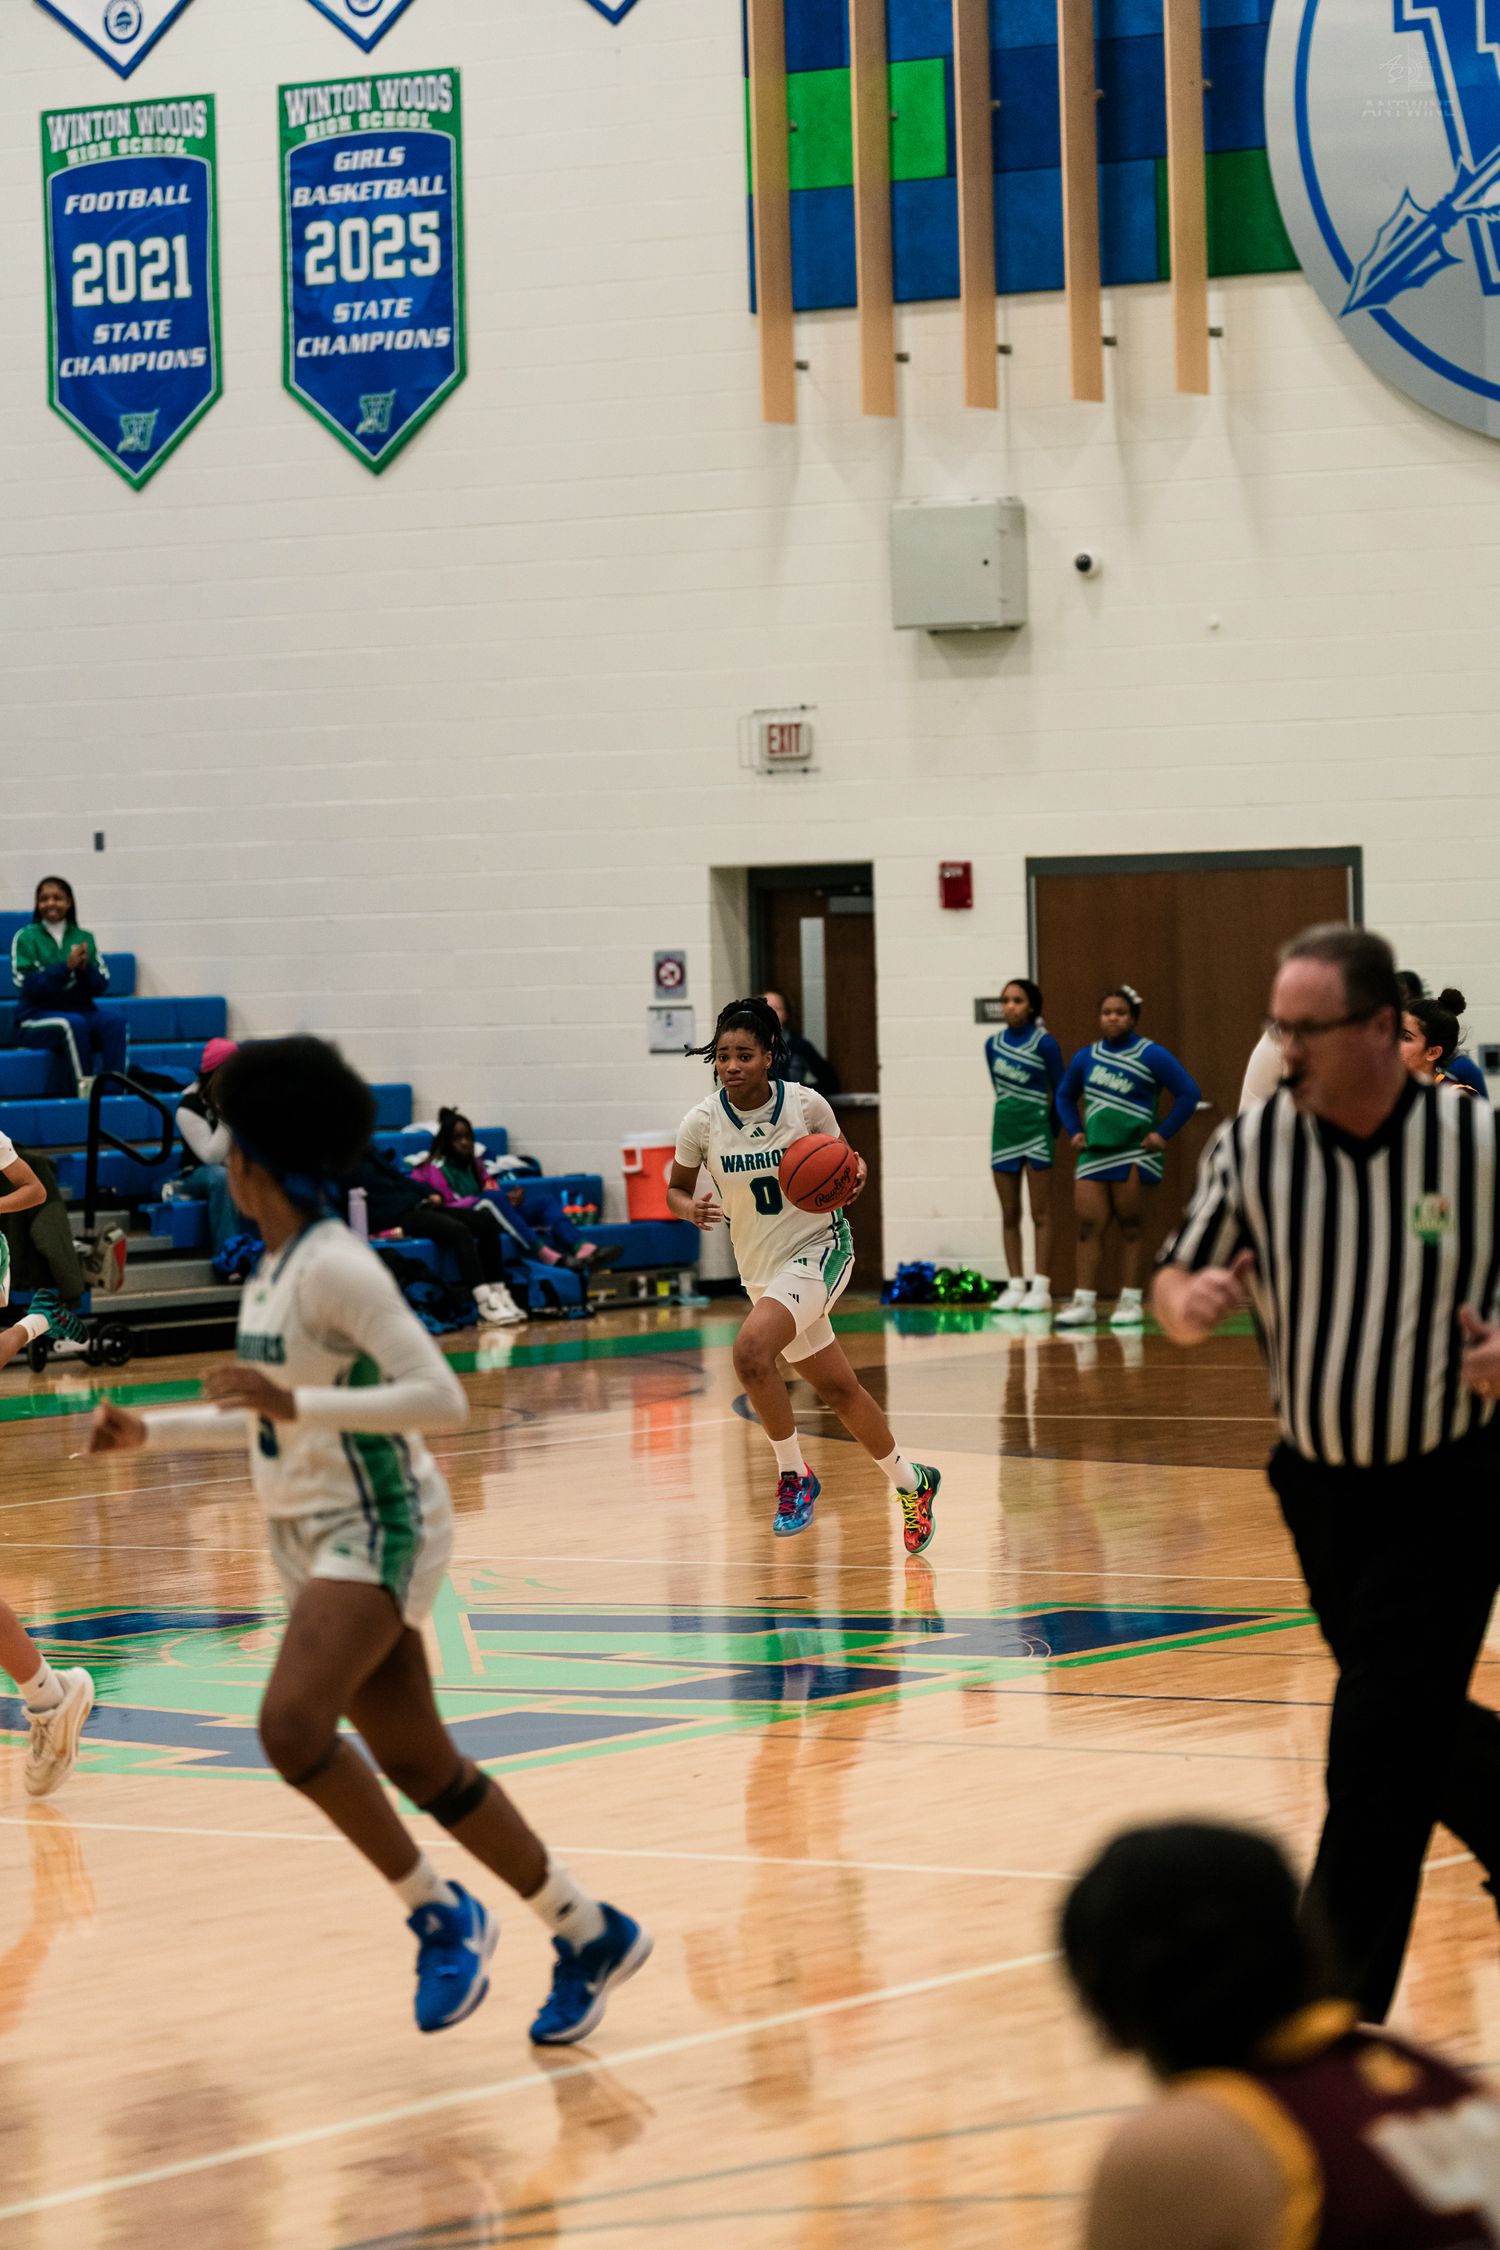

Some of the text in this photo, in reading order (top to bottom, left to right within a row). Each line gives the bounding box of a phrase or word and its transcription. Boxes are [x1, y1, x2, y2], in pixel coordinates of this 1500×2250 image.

[284, 74, 453, 128] WINTON WOODS
[47, 100, 207, 153] WINTON WOODS
[304, 110, 432, 140] HIGH SCHOOL
[66, 137, 187, 165] HIGH SCHOOL
[333, 146, 406, 172] GIRLS
[64, 183, 192, 215] FOOTBALL
[292, 174, 447, 208] BASKETBALL
[304, 210, 441, 286] 2025
[72, 234, 192, 307] 2021
[332, 297, 413, 324] STATE
[93, 318, 172, 345] STATE
[296, 326, 451, 358] CHAMPIONS
[60, 346, 207, 378] CHAMPIONS
[768, 723, 801, 753] EXIT
[720, 1148, 788, 1173] WARRIO
[749, 1175, 783, 1215] 0
[815, 1166, 851, 1207] Rawlings
